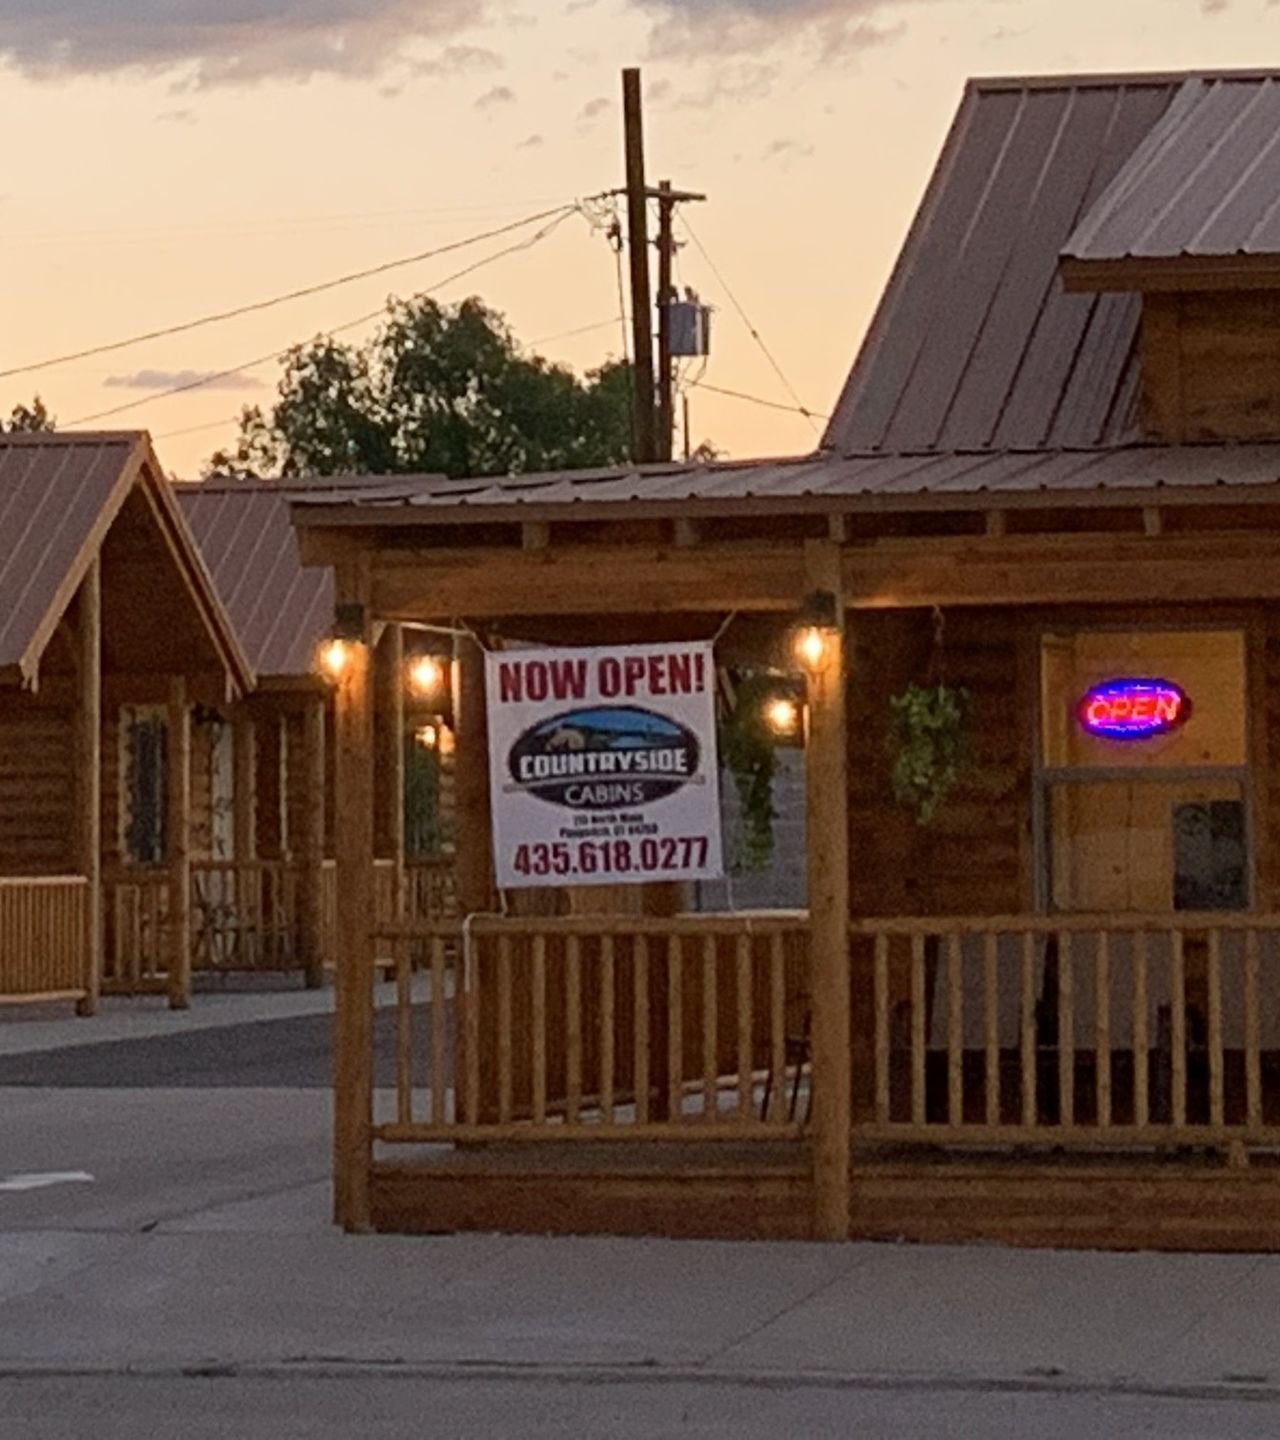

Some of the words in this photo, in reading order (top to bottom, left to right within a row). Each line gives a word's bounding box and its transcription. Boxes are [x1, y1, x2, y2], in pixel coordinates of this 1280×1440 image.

[499, 658, 587, 702] NOW
[598, 653, 705, 699] OPEN!
[1087, 691, 1180, 725] OPEN
[520, 748, 689, 779] COUNTRYSIDE
[564, 782, 645, 805] CABINS
[513, 837, 709, 876] 435.618.0277
